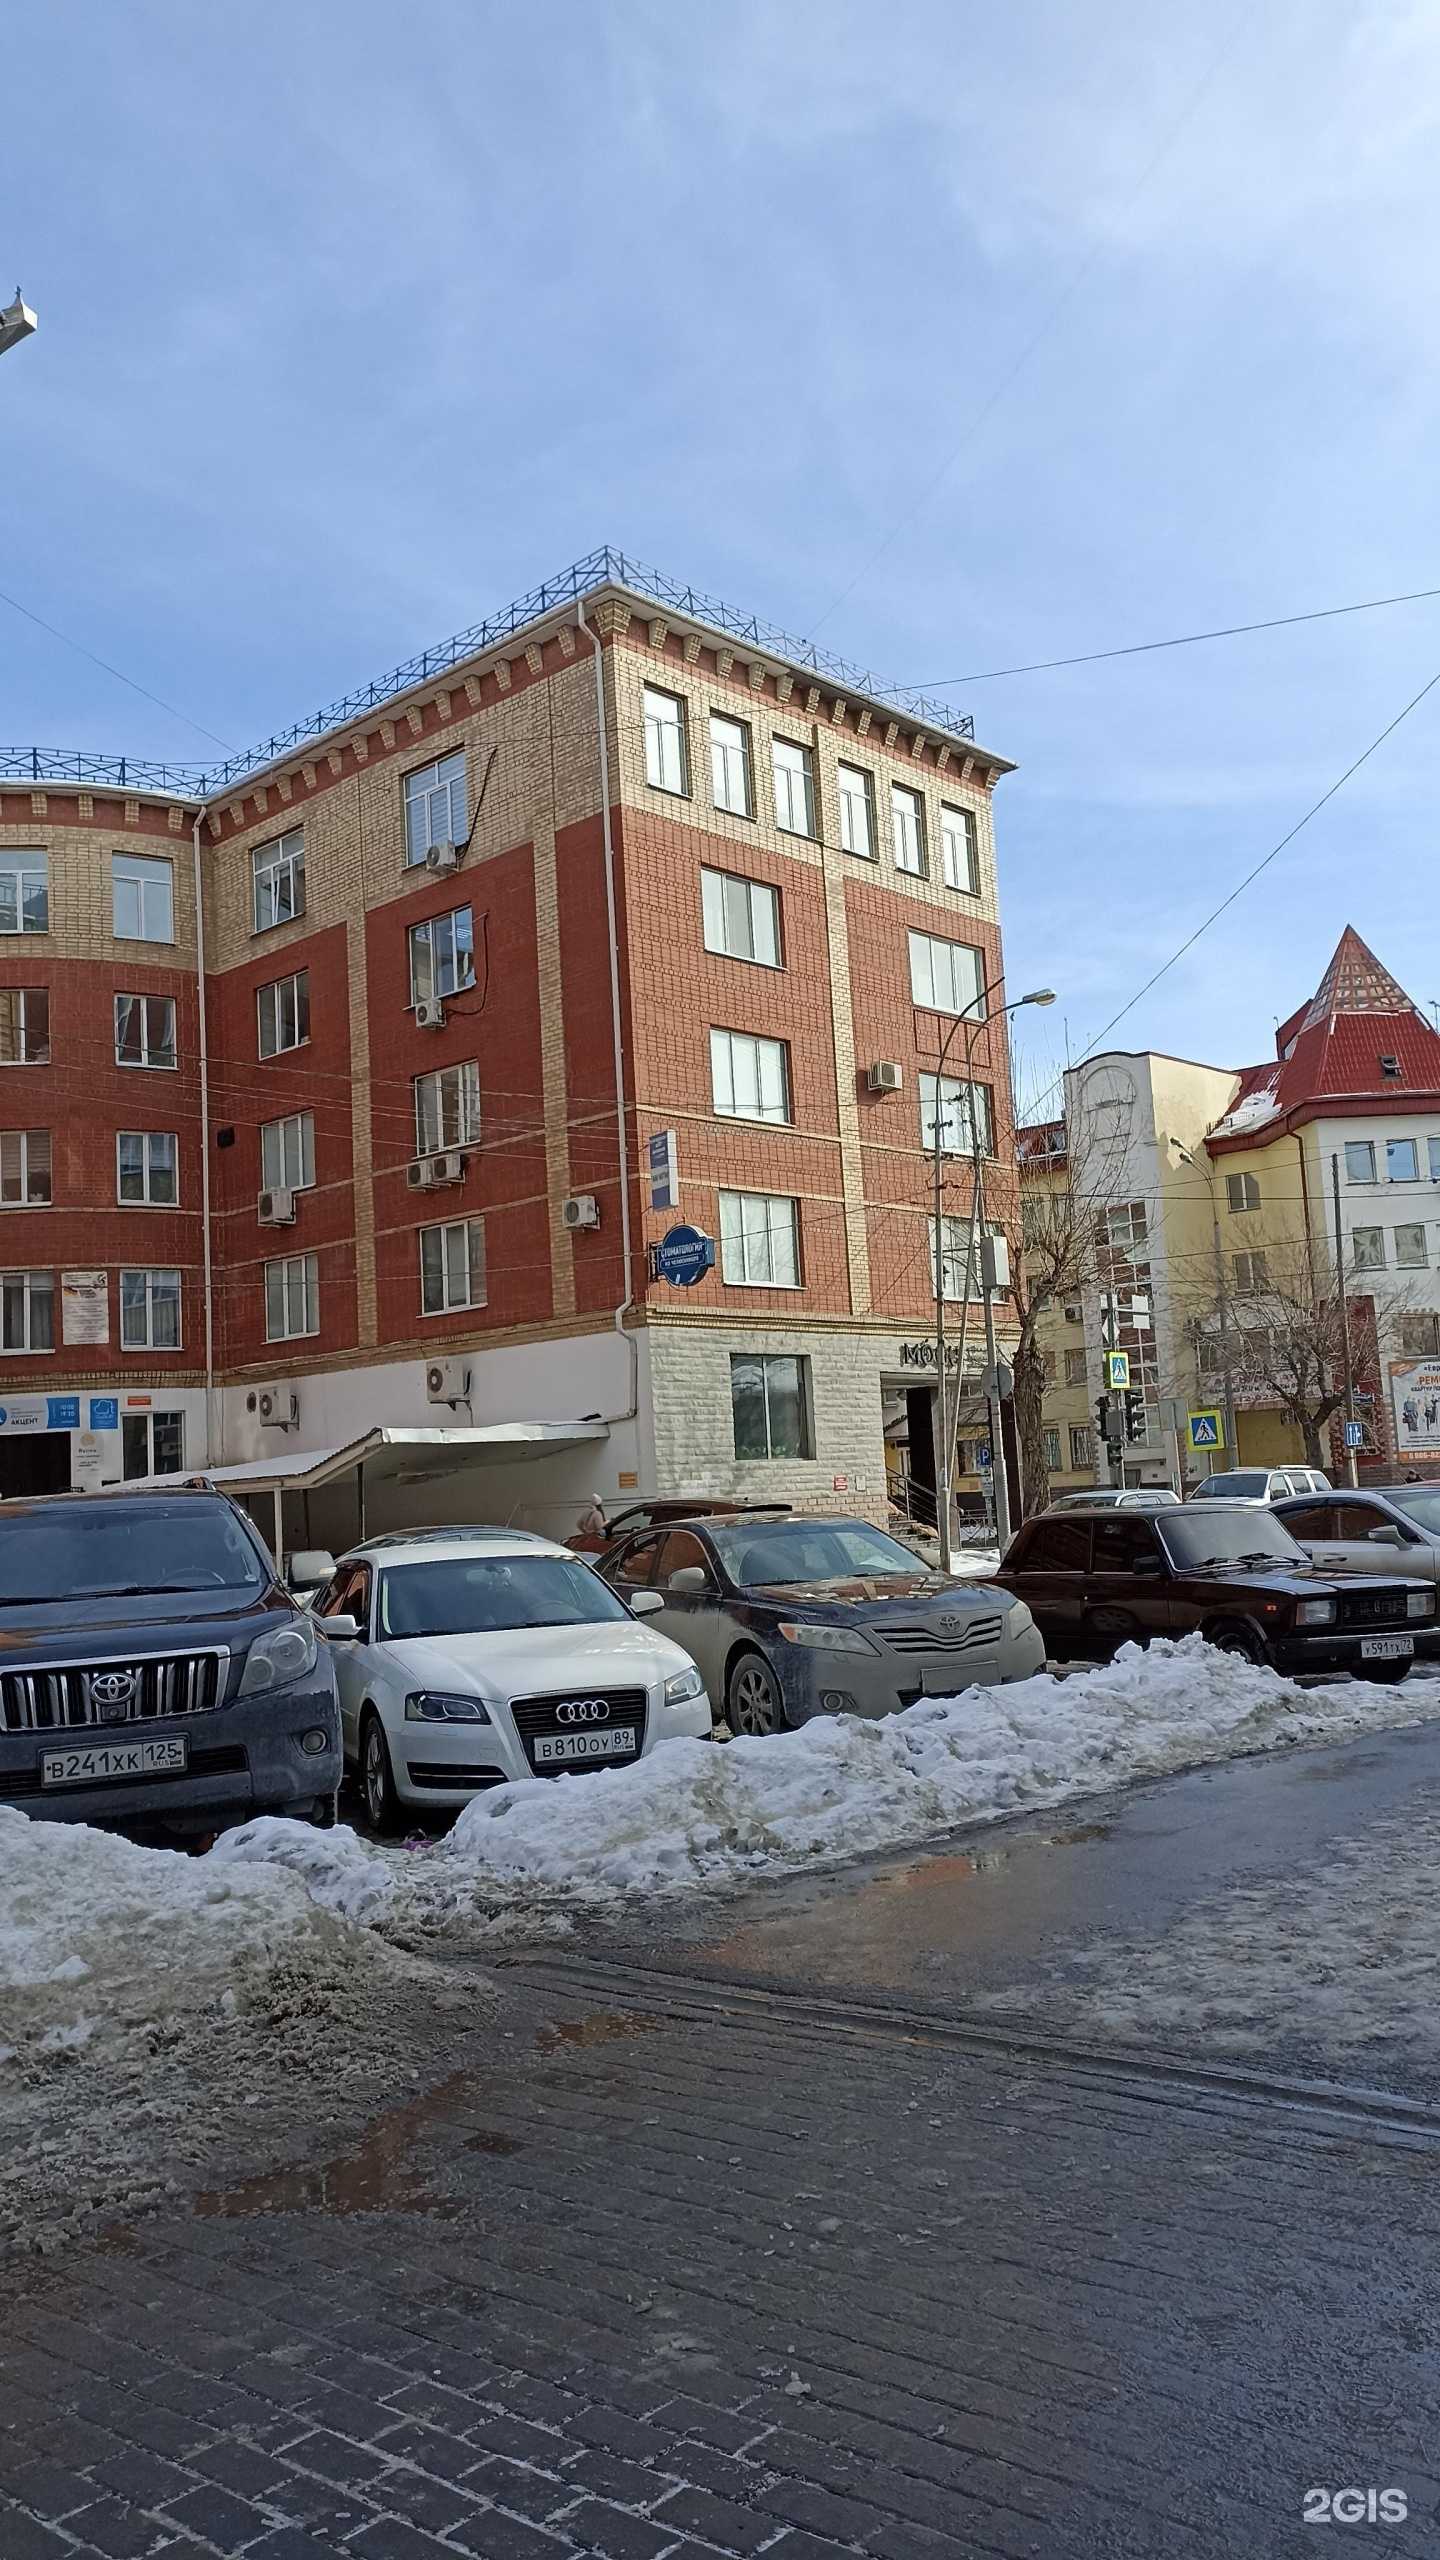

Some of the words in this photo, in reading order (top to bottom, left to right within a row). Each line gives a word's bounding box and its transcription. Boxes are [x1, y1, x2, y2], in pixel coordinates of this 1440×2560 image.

[1419, 1376, 1440, 1385] РЕМ
[542, 1737, 608, 1757] В810ОУ
[614, 1731, 629, 1744] 89
[52, 1751, 140, 1779] В241ХК
[145, 1743, 177, 1761] 125
